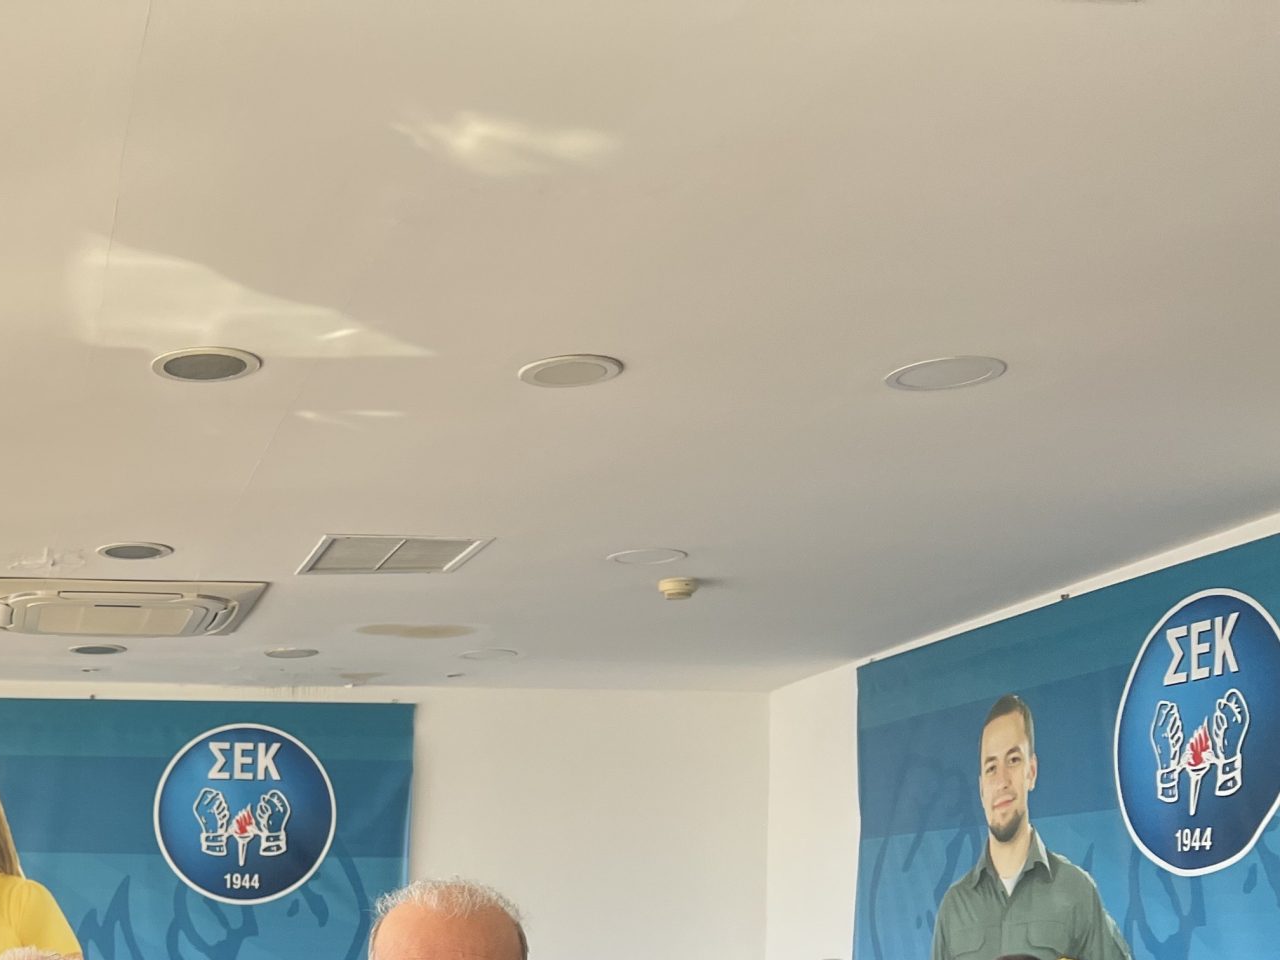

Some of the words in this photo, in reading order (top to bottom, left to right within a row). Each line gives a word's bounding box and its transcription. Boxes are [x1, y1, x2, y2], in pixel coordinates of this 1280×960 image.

[1163, 611, 1240, 687] ΣΕΚ
[207, 741, 282, 781] ΣΕΚ
[1175, 827, 1212, 852] 1944
[223, 872, 260, 889] 1944
